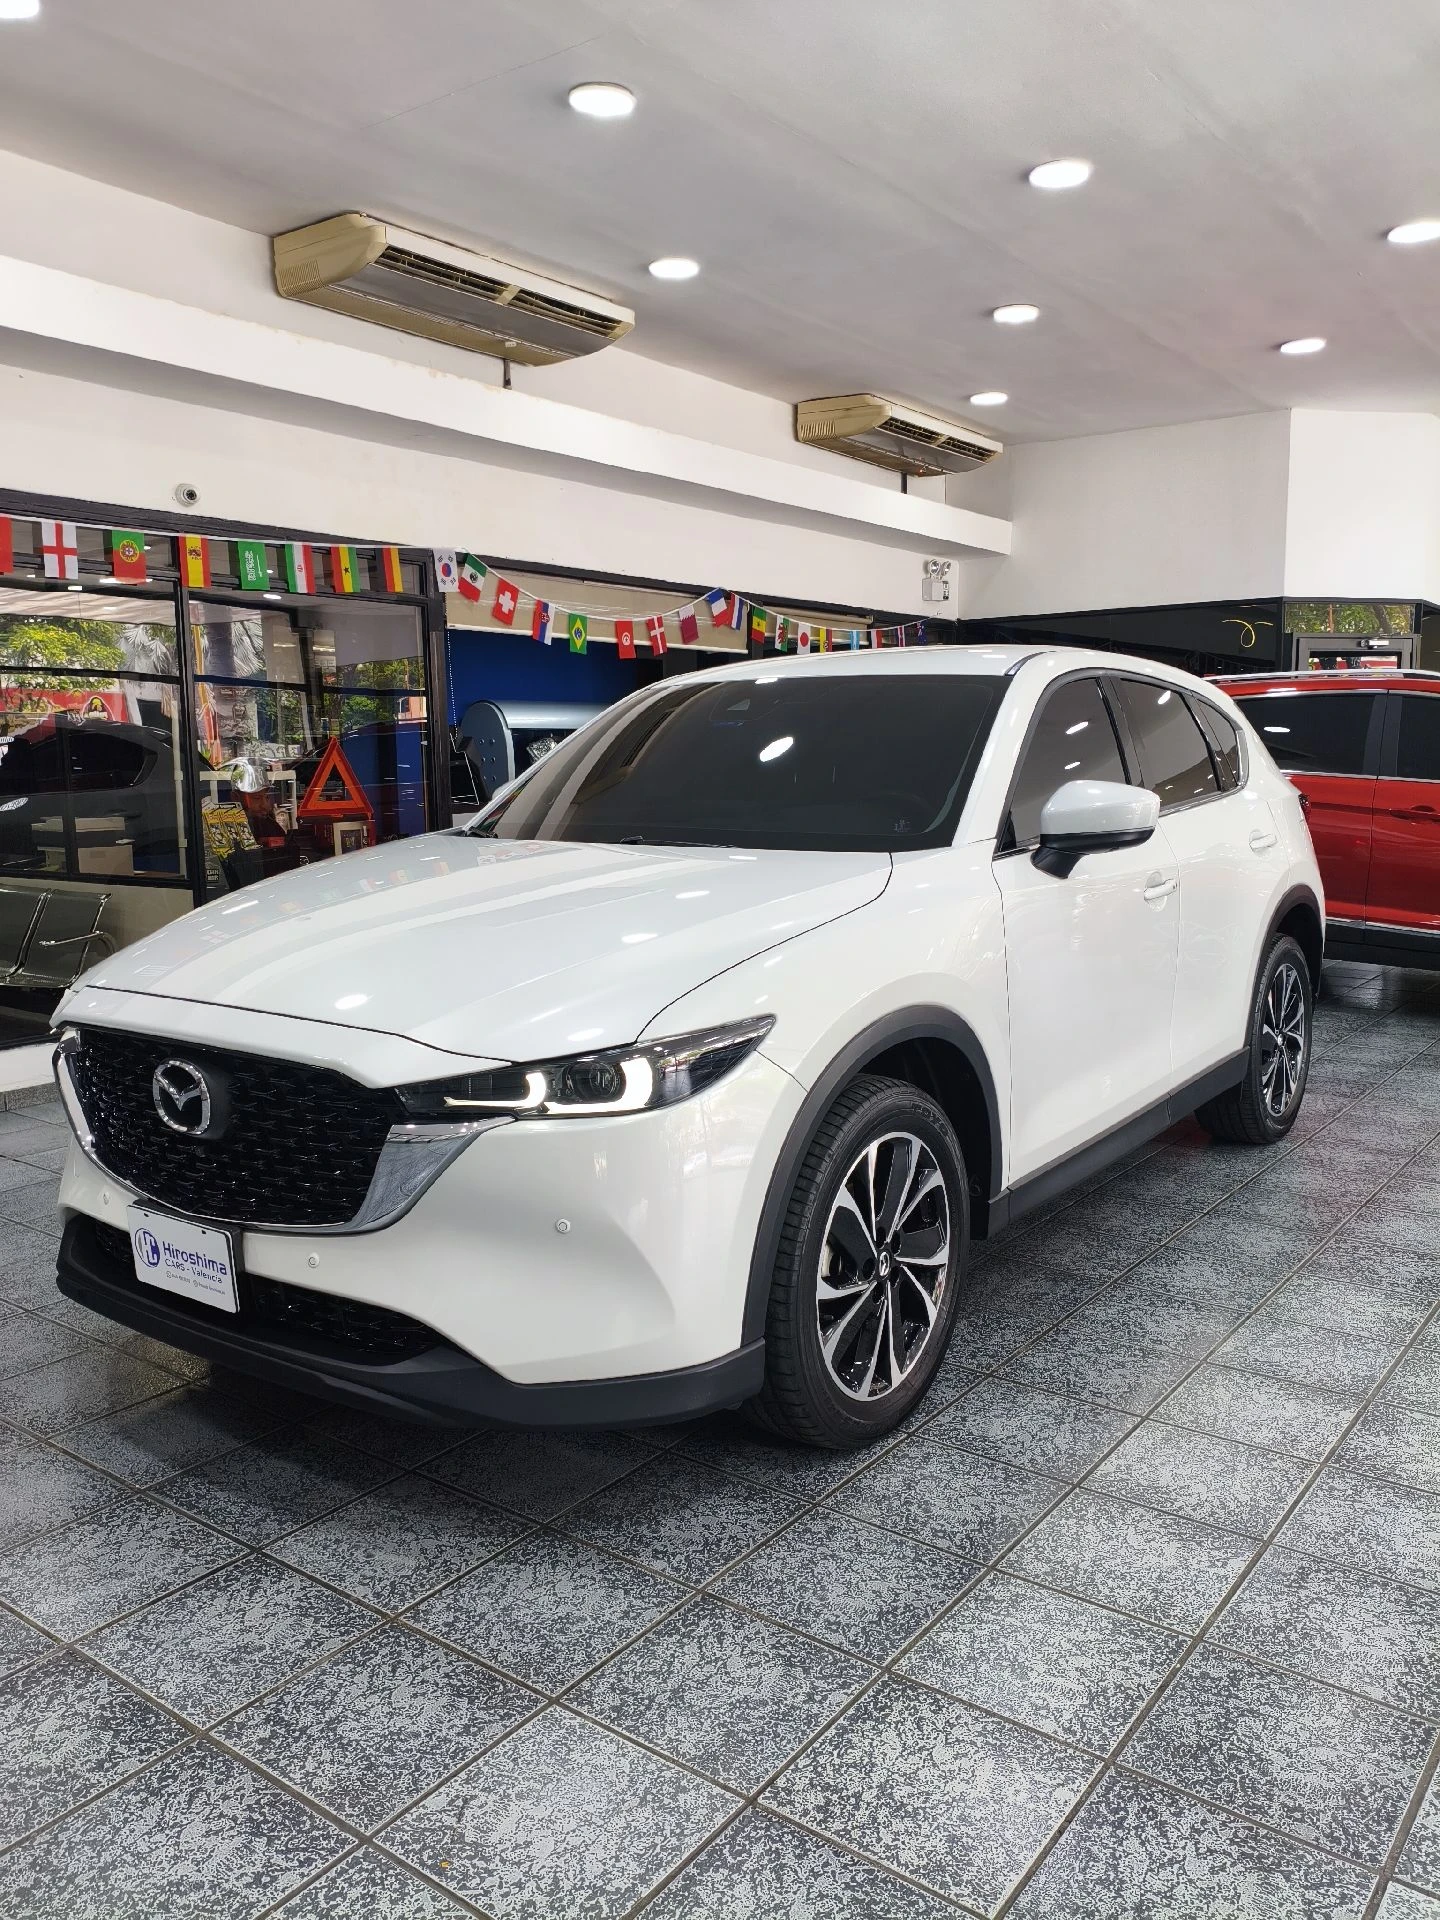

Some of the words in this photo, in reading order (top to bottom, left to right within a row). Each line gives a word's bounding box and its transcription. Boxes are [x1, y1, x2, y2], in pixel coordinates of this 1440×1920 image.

[162, 1241, 227, 1275] Hiroshima
[165, 1259, 185, 1271] CARS
[192, 1267, 222, 1283] Valencia
